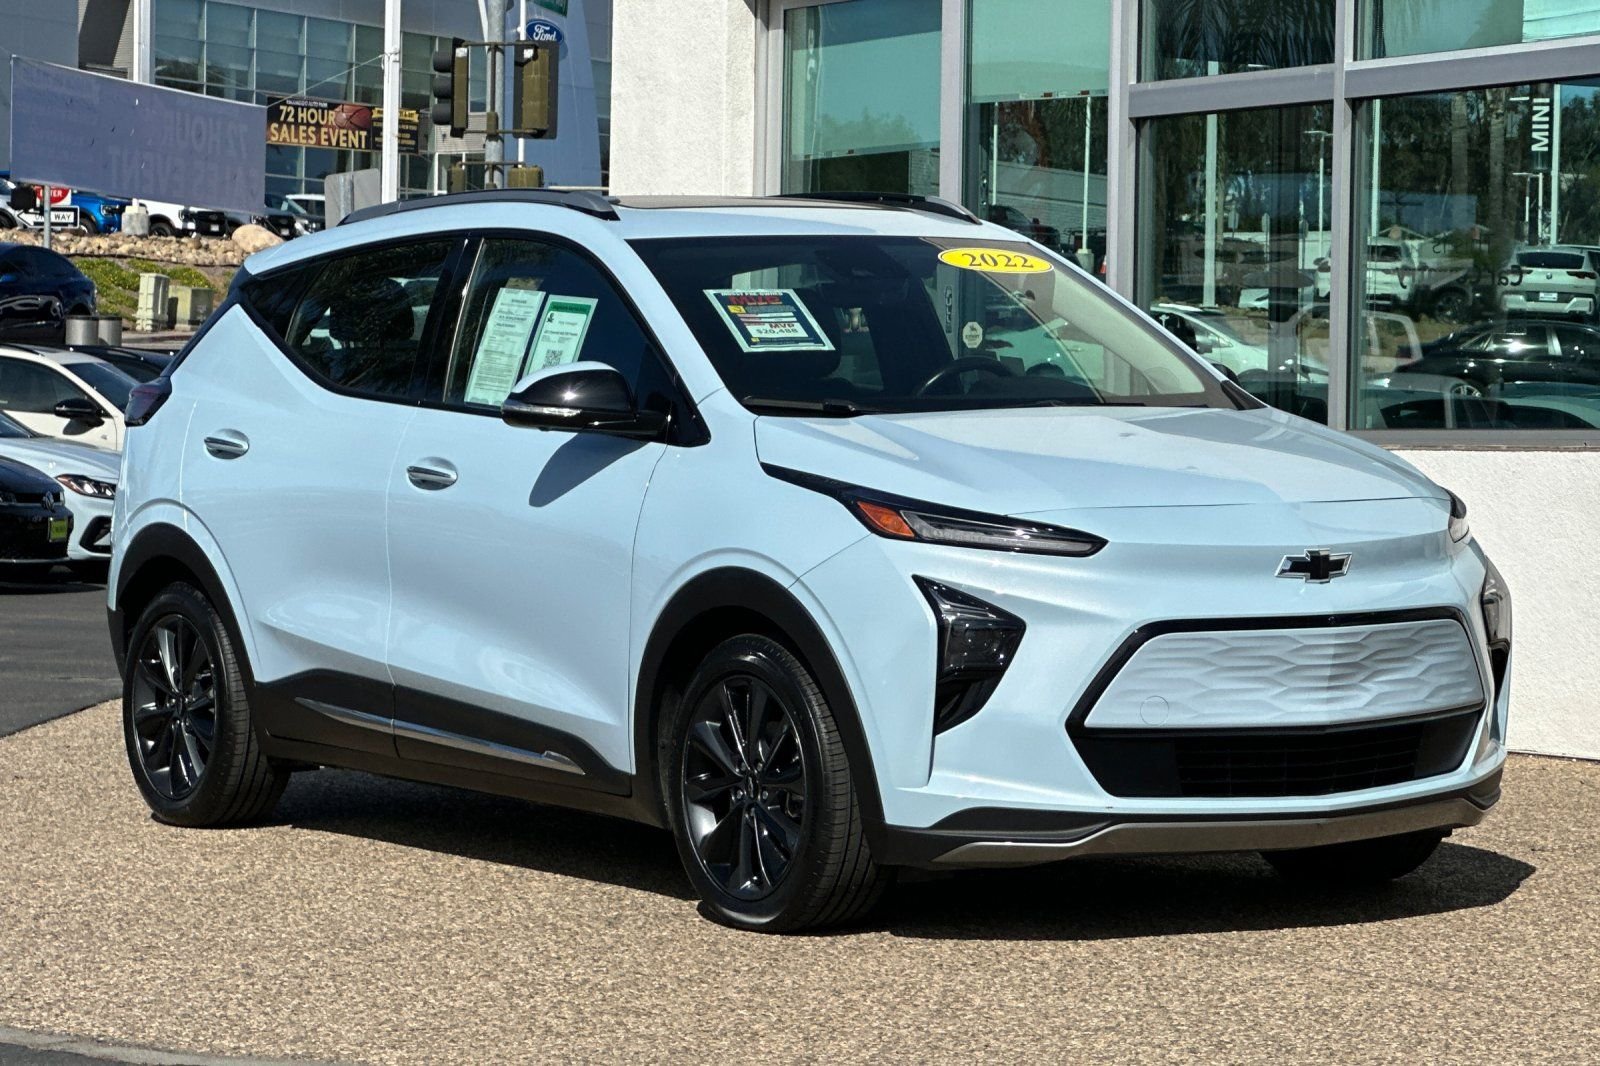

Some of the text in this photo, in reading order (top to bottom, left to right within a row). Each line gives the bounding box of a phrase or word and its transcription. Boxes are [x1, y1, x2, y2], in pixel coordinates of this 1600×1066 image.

[533, 24, 557, 41] Ford
[279, 105, 336, 126] 72 HOUR
[1531, 97, 1550, 152] MINI
[270, 122, 317, 145] SALES
[321, 127, 367, 149] EVENT
[961, 253, 1034, 268] 2022
